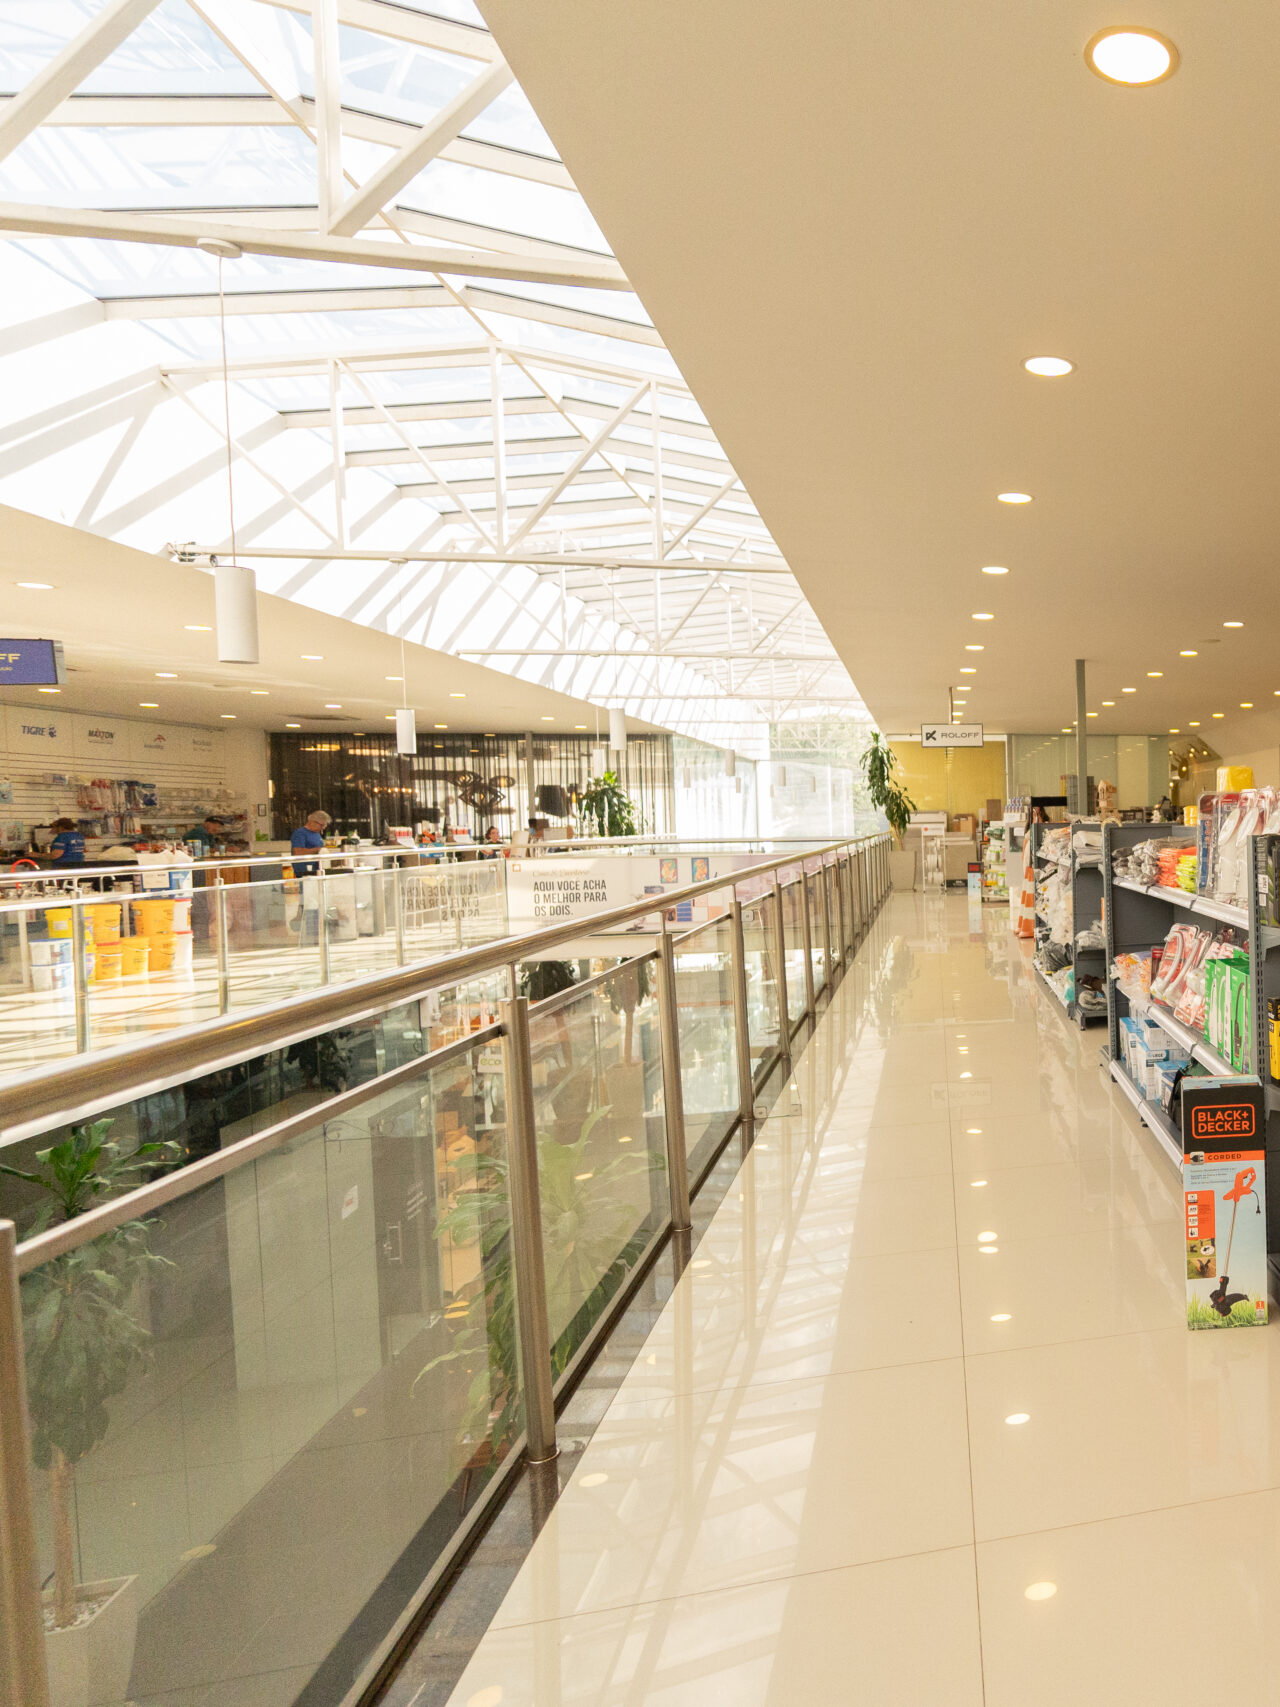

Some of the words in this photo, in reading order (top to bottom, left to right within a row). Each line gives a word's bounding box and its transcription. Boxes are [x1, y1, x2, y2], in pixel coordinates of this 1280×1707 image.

[21, 725, 46, 737] TIGRE
[533, 881, 555, 891] AQUI
[583, 879, 607, 890] ACHA
[534, 894, 540, 904] O
[543, 893, 581, 903] MELHOR
[583, 891, 608, 902] PARA
[534, 906, 547, 917] OS
[550, 905, 574, 916] DOIS.
[1197, 1110, 1249, 1121] BLACK+
[1197, 1121, 1250, 1133] DECKER
[1207, 1153, 1242, 1161] CORDED
